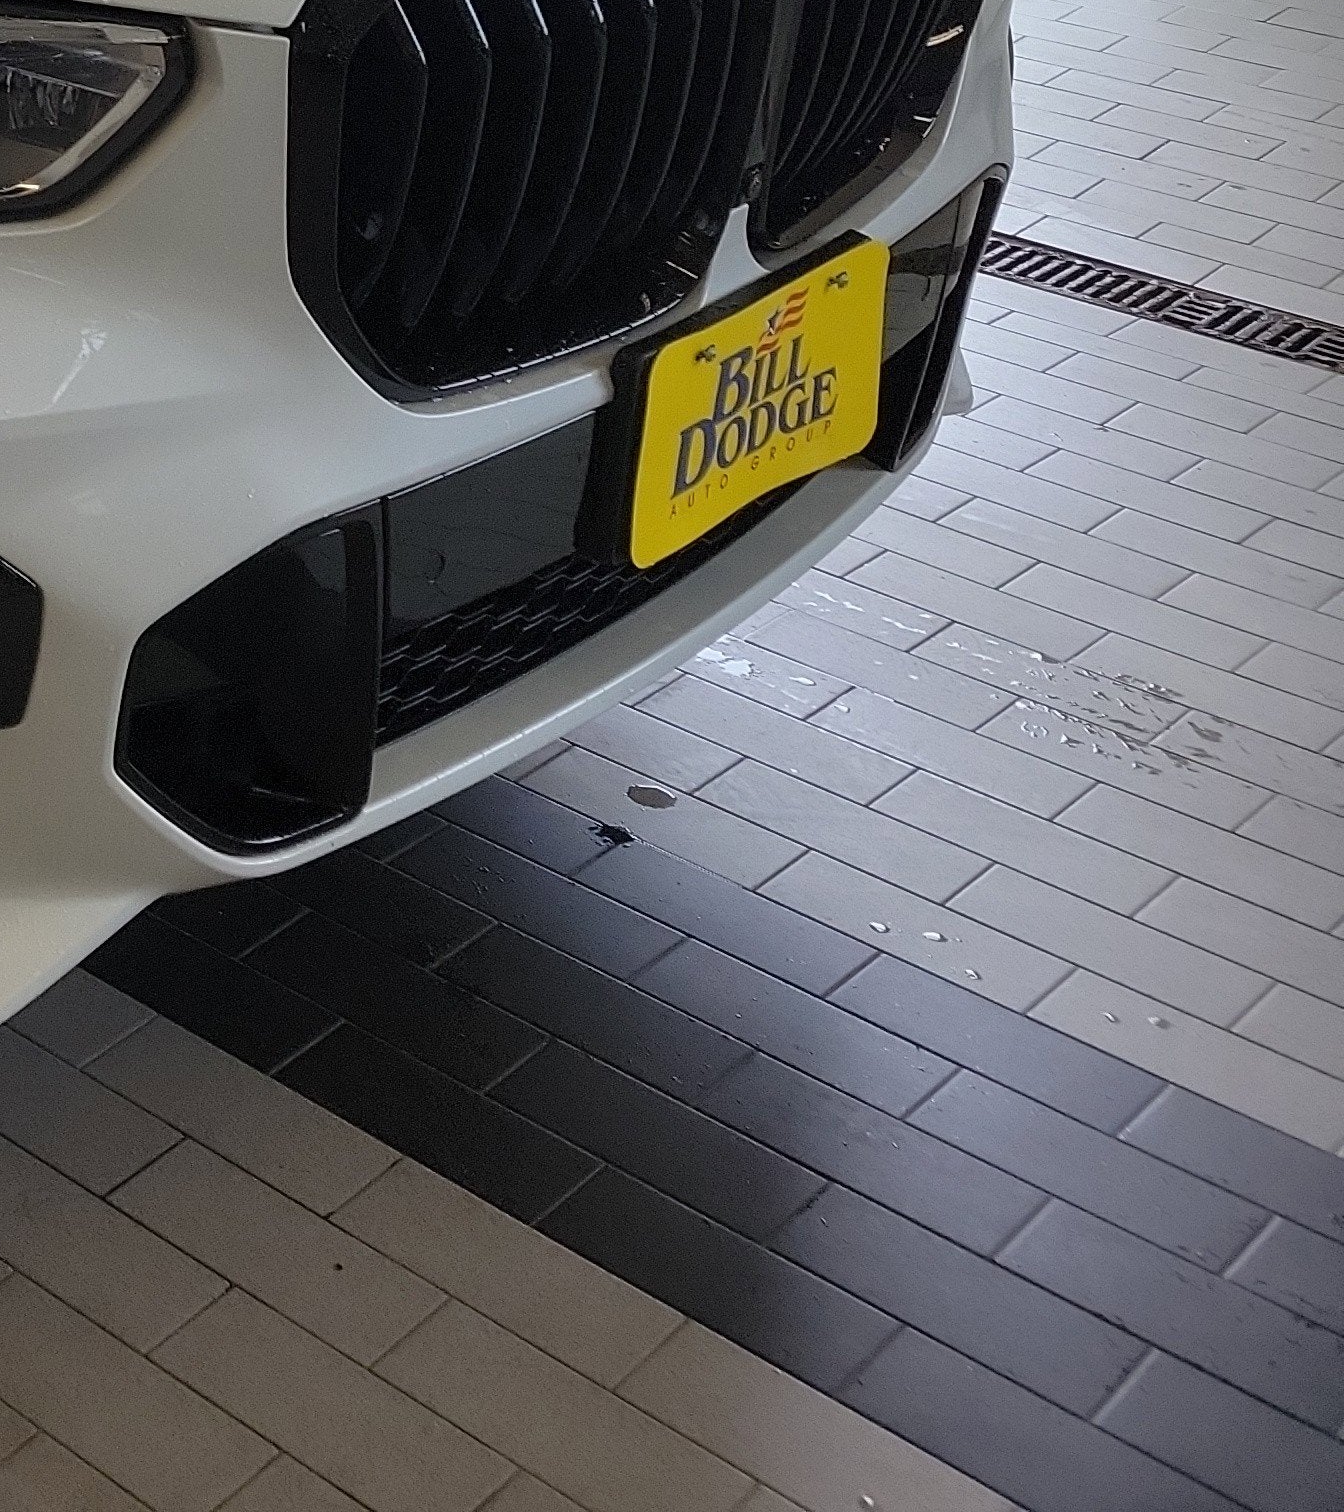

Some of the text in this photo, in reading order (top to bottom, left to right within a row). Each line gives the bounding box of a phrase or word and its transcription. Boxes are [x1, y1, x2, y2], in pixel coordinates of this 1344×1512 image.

[712, 334, 812, 424] BILL
[670, 368, 839, 500] DODGE
[670, 420, 831, 519] AUTO GROUP
